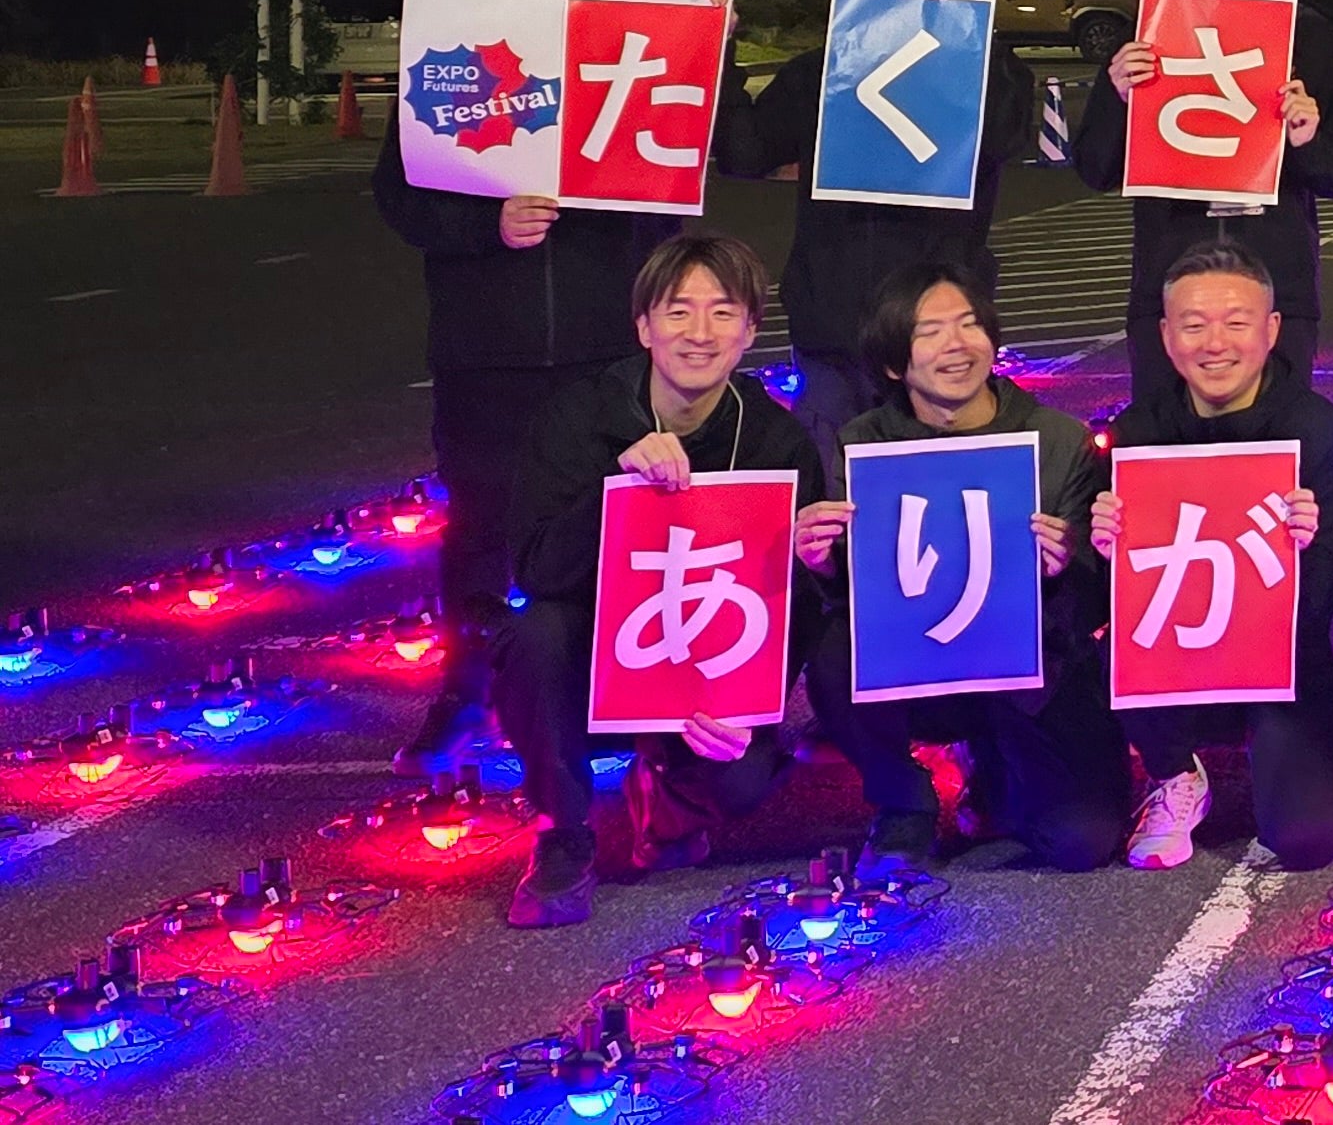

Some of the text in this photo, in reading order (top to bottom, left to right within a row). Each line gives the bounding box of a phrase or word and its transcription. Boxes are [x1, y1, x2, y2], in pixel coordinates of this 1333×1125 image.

[423, 65, 480, 81] EXPO
[423, 80, 480, 93] Futures
[432, 84, 557, 127] Festival
[580, 31, 704, 167] た
[856, 28, 941, 164] く
[1158, 27, 1264, 157] さ
[615, 526, 769, 679] あ
[897, 489, 992, 644] り
[1128, 492, 1290, 649] が
